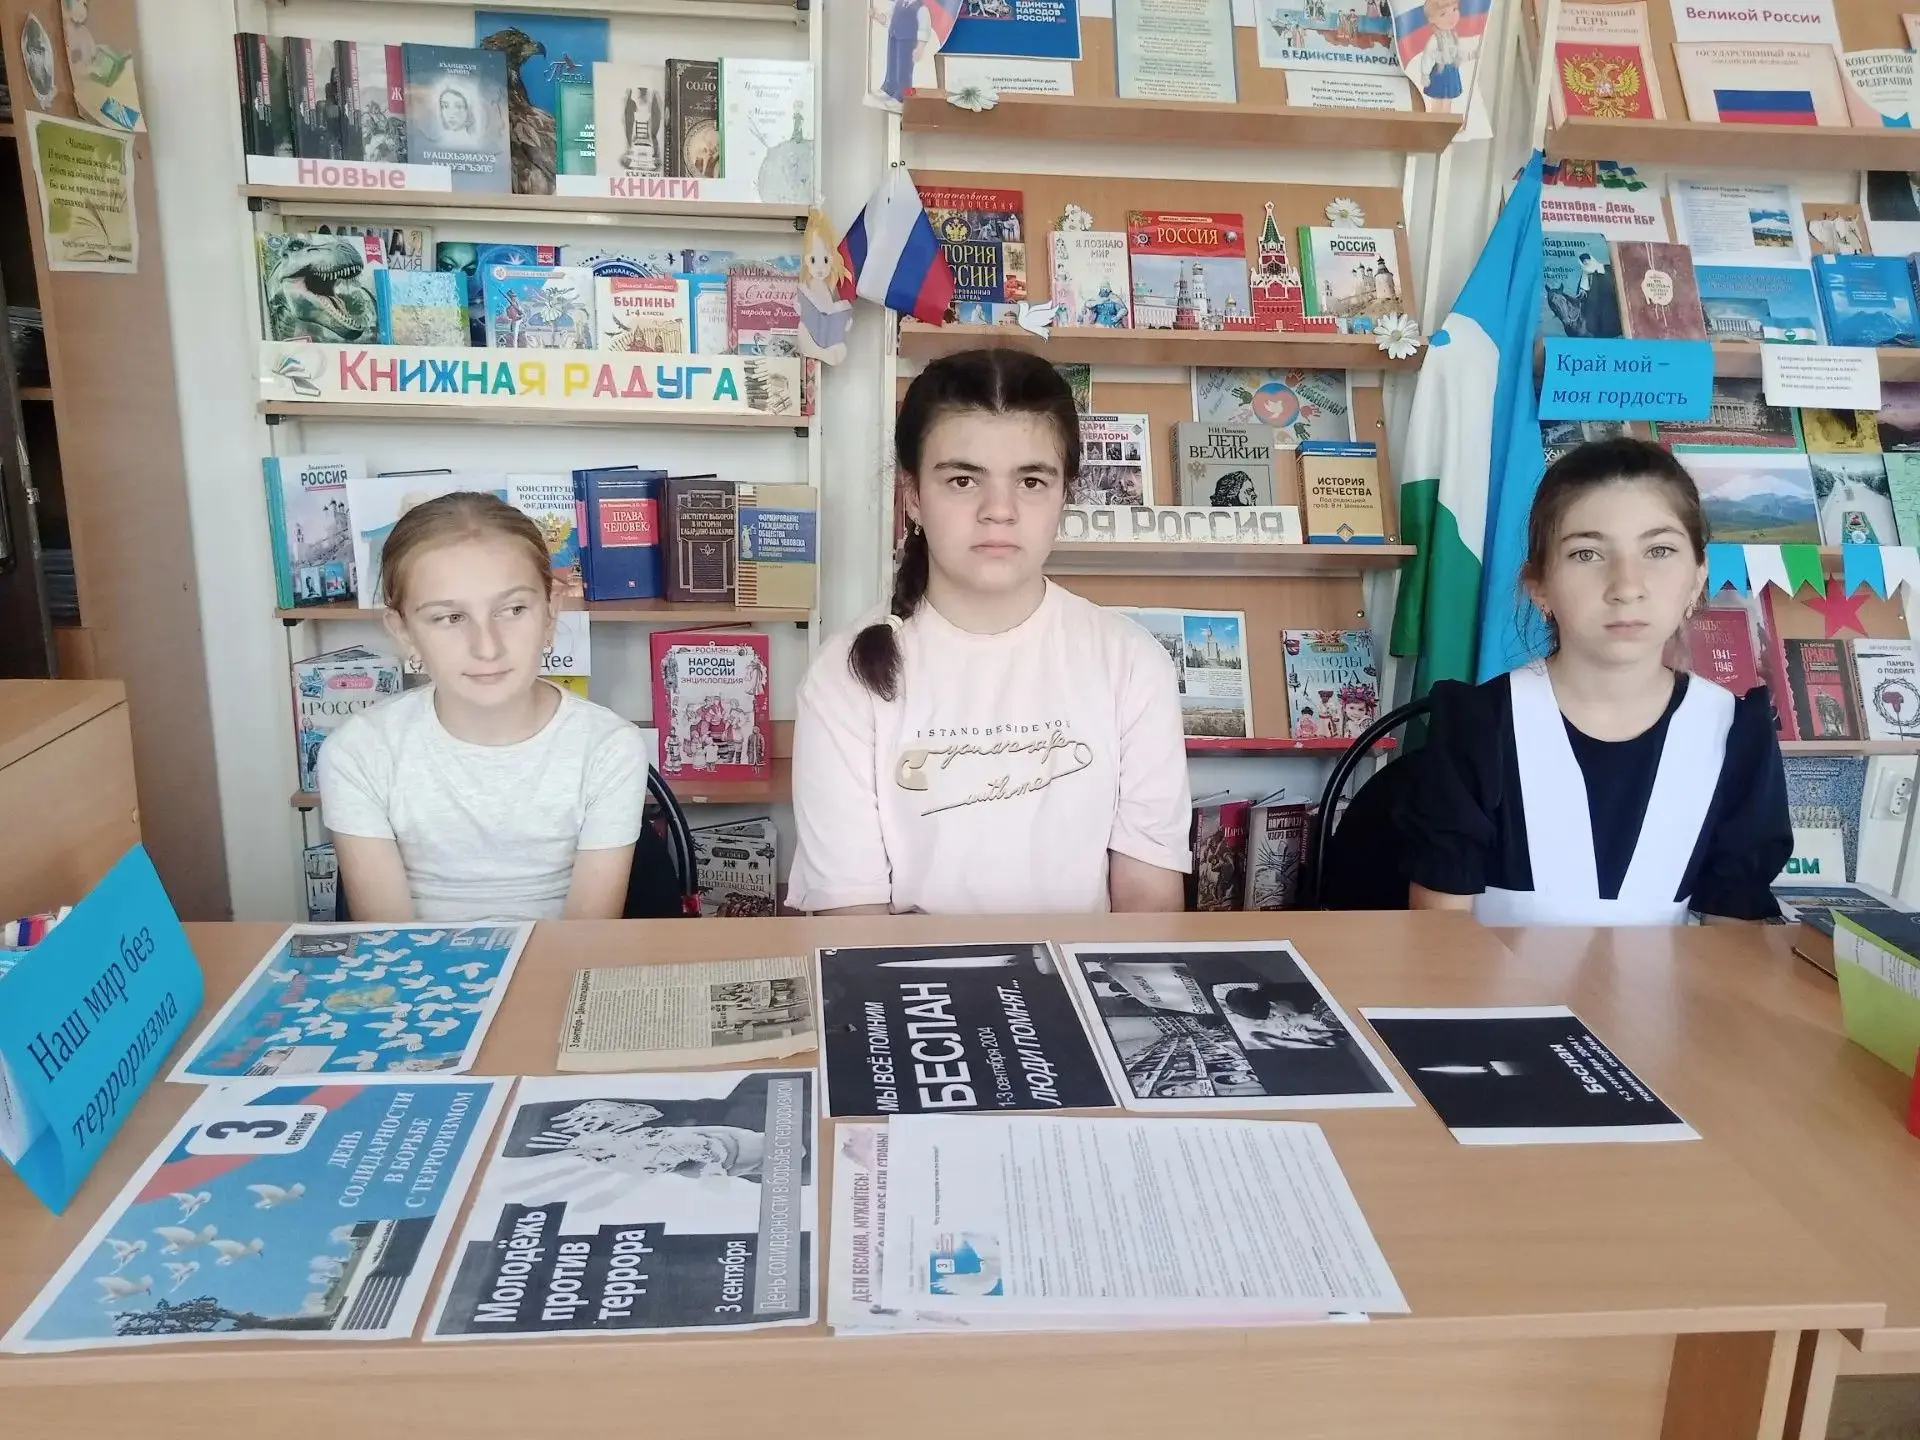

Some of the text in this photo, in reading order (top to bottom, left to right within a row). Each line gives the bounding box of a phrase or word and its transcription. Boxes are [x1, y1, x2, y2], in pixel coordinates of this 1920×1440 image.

[1016, 8, 1061, 16] НАРОДОВ
[1016, 15, 1056, 23] РОССИИ
[1686, 6, 1821, 24] Великой России
[1281, 49, 1290, 59] В
[1292, 50, 1354, 63] ЕДИНСТВЕ
[1845, 54, 1913, 67] КОНСТИТУЦИЯ
[1850, 65, 1914, 78] РОССИЙСКОЙ
[298, 158, 406, 189] Новые
[1541, 200, 1596, 212] сентября
[1606, 202, 1635, 214] День
[1542, 212, 1632, 225] дарственности
[1084, 239, 1124, 249] ПОЗНАЮ
[1157, 227, 1218, 245] РОССИЯ
[940, 244, 997, 264] ТОРИЯ
[1090, 249, 1110, 258] МИР
[1330, 240, 1376, 253] РОССИЯ
[613, 296, 675, 309] БЫЛИНЫ
[1556, 352, 1608, 375] Край
[1613, 353, 1650, 374] мой
[339, 350, 739, 401] КНИЖНАЯ РАДУГА
[1551, 389, 1689, 407] моя гордость
[1208, 434, 1248, 447] ПЕТР
[1189, 446, 1270, 461] ВЕЛИКИЙ
[301, 470, 348, 486] РОССИЯ
[1317, 477, 1365, 486] ИСТОРИЯ
[1312, 486, 1373, 496] ОТЕЧЕСТВА
[612, 511, 645, 522] ПРАВА
[758, 514, 800, 523] ФОРМИРОВАНИЕ
[1131, 507, 1284, 542] РОССИЯ
[758, 522, 800, 531] ГРАЖДАНСКОГО
[758, 530, 786, 538] ОБЩЕСТВА
[763, 538, 780, 546] ПРАВА
[781, 538, 806, 547] ЧЕЛОВЕКА
[688, 657, 736, 668] НАРОДЫ
[1301, 656, 1364, 669] НАРОДЫ
[1713, 660, 1734, 674] 1945
[688, 666, 736, 677] РОССИИ
[1307, 669, 1362, 685] МИРА
[680, 676, 745, 686] ЭНЦИКЛОПЕДИЯ
[917, 730, 921, 738] I
[928, 727, 980, 737] STAND
[985, 724, 1040, 736] BESIDE
[697, 868, 764, 885] ВОЕННАЯ
[26, 926, 156, 1084] Наш мир без
[899, 982, 979, 1109] БЕСЛАН
[996, 979, 1064, 1107] ЛЮДИ ПОМНЯТ...
[864, 1001, 900, 1112] МЫ ВСЁ ПОМНИМ
[71, 990, 179, 1150] терроризма
[976, 1026, 1015, 1107] 1-3 сентября 2004
[1549, 1043, 1608, 1094] Беслан
[1617, 1068, 1655, 1103] помним,
[205, 1119, 288, 1140] 3
[285, 1112, 318, 1145] сентября
[327, 1130, 363, 1168] ДЕНЬ
[338, 1091, 416, 1208] СОЛИДАРНОСТИ
[384, 1117, 433, 1184] В БОРЬБЕ
[405, 1091, 475, 1208] С ТЕРРОРИЗМОМ
[876, 1132, 889, 1168] СТРАНЫ!
[760, 1080, 793, 1310] День солидарности в борьбе с терроризмом
[850, 1173, 873, 1304] ДЕТИ БЕСЛАНА, МУЖАЙТЕСЬ!
[473, 1210, 548, 1323] Молодёжь
[597, 1229, 654, 1321] террора
[541, 1240, 592, 1322] против
[714, 1239, 748, 1314] 3 сентября
